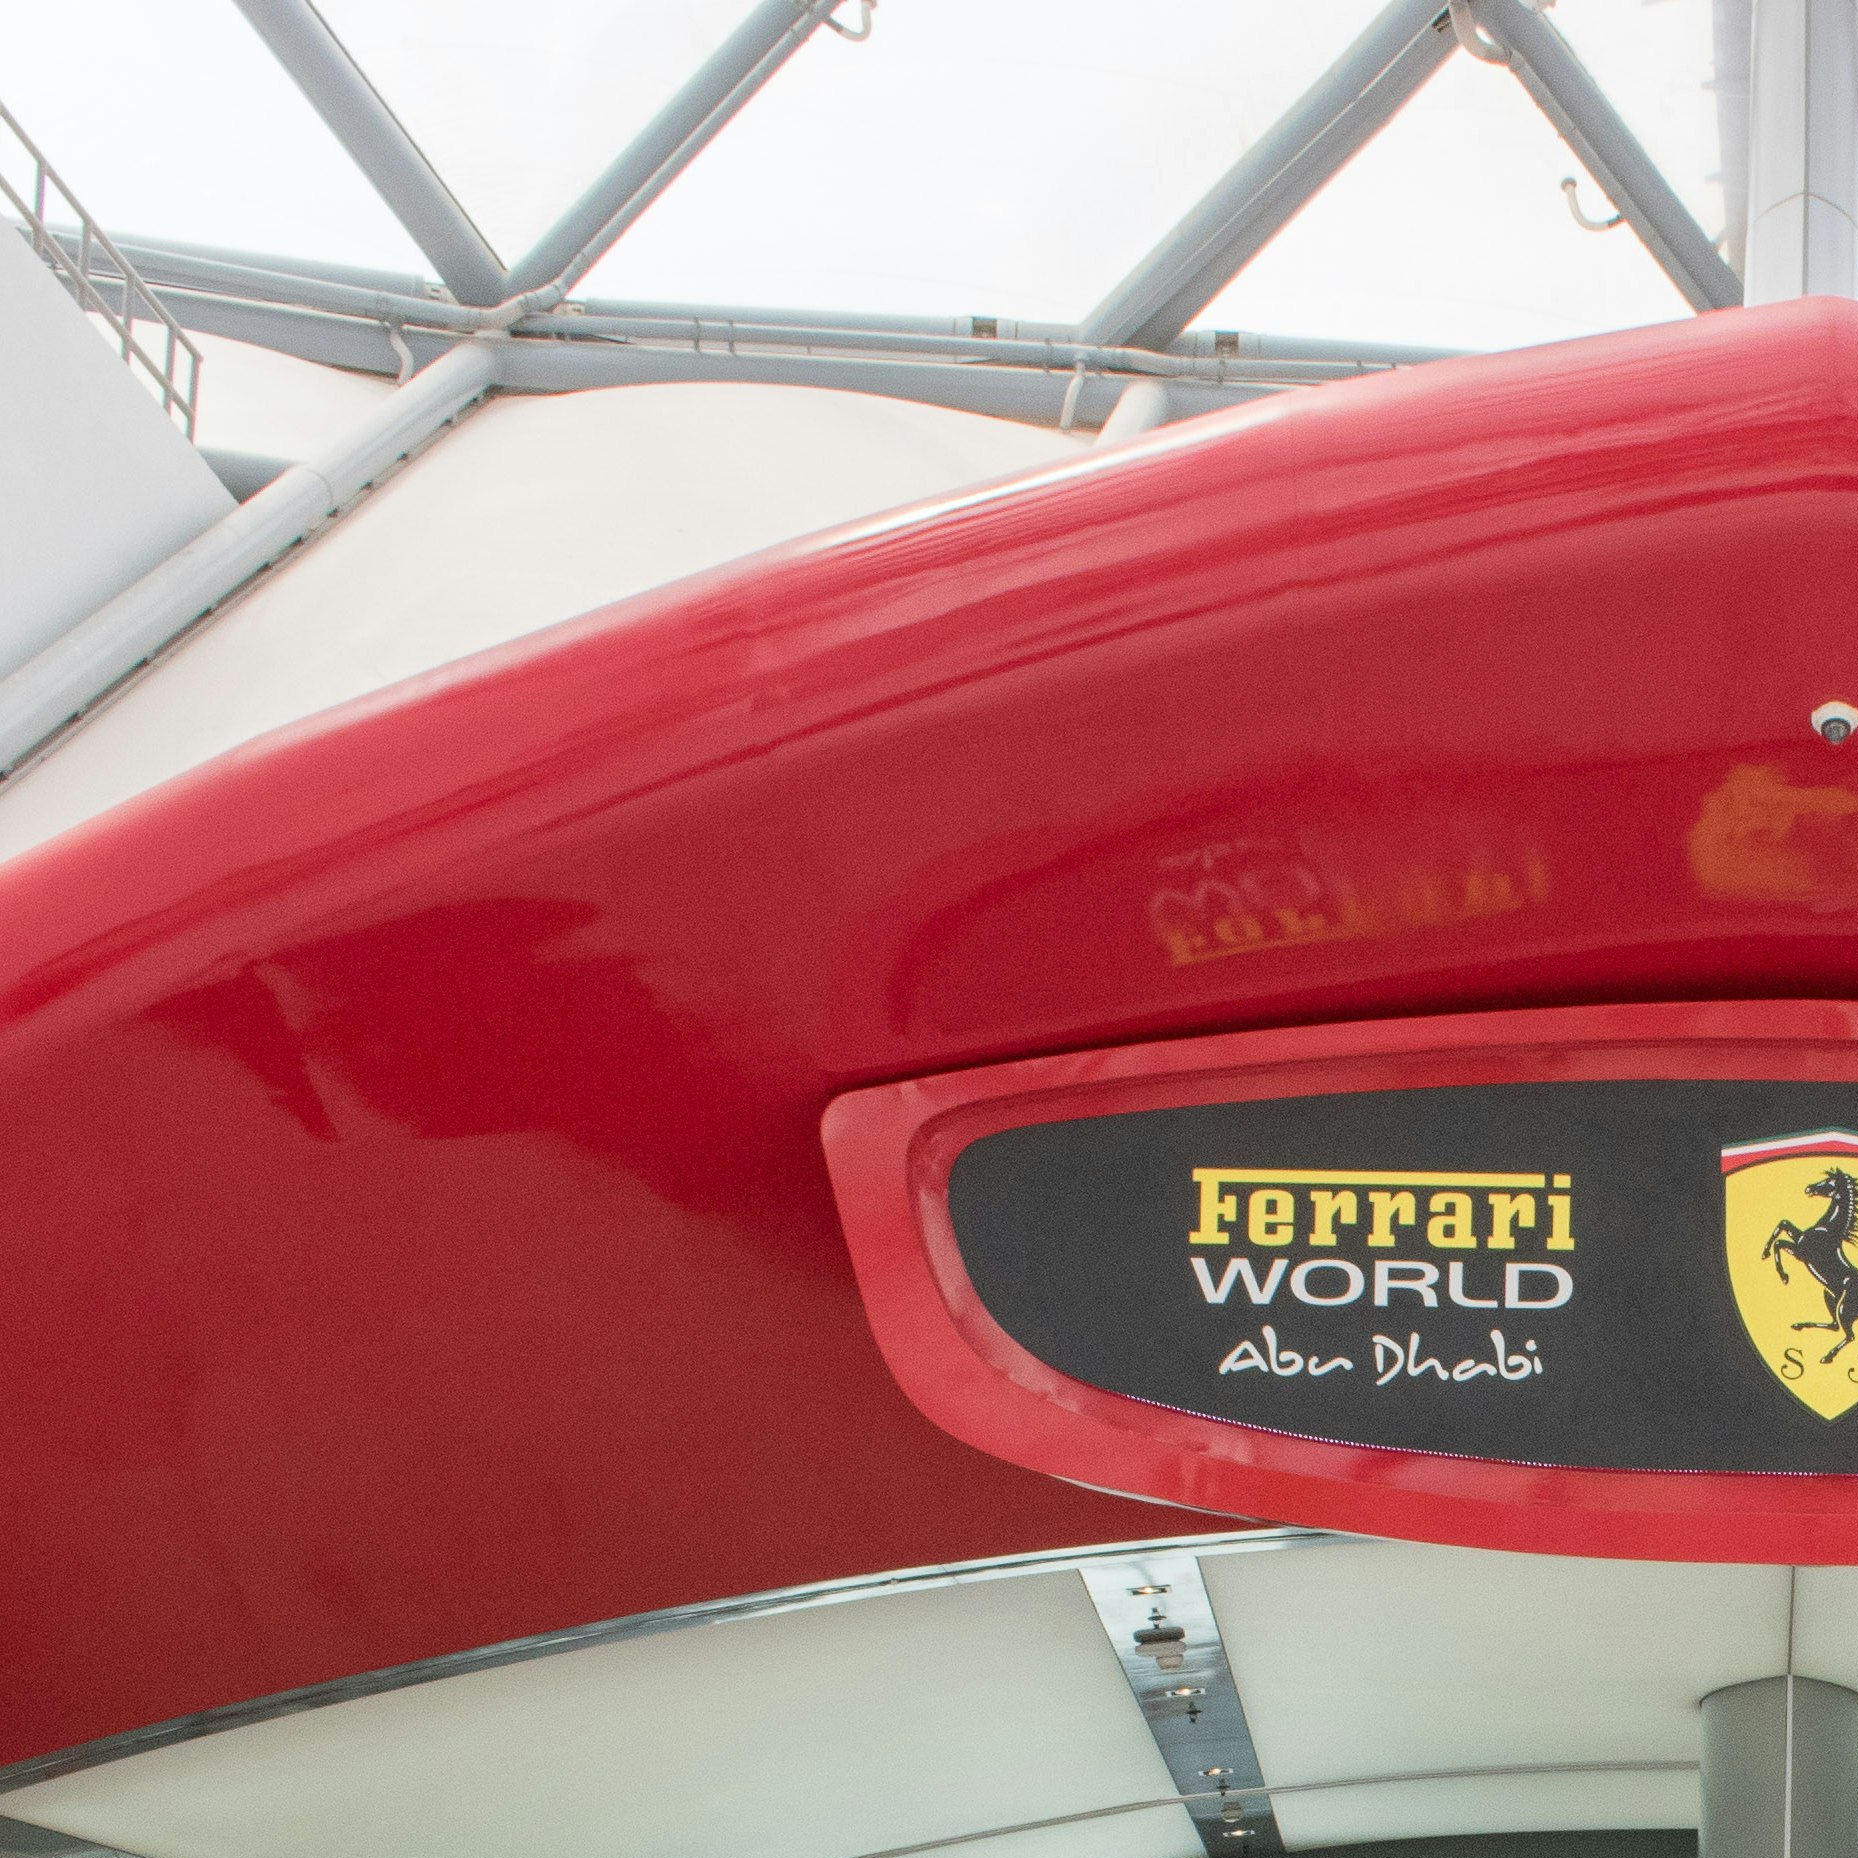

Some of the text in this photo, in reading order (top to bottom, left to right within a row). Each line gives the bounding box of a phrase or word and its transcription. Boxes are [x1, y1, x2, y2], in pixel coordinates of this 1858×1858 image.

[1188, 1168, 1575, 1250] Ferrari
[1190, 1257, 1574, 1309] WORLD
[1218, 1325, 1543, 1386] Abu Dhabi
[1780, 1347, 1805, 1380] S
